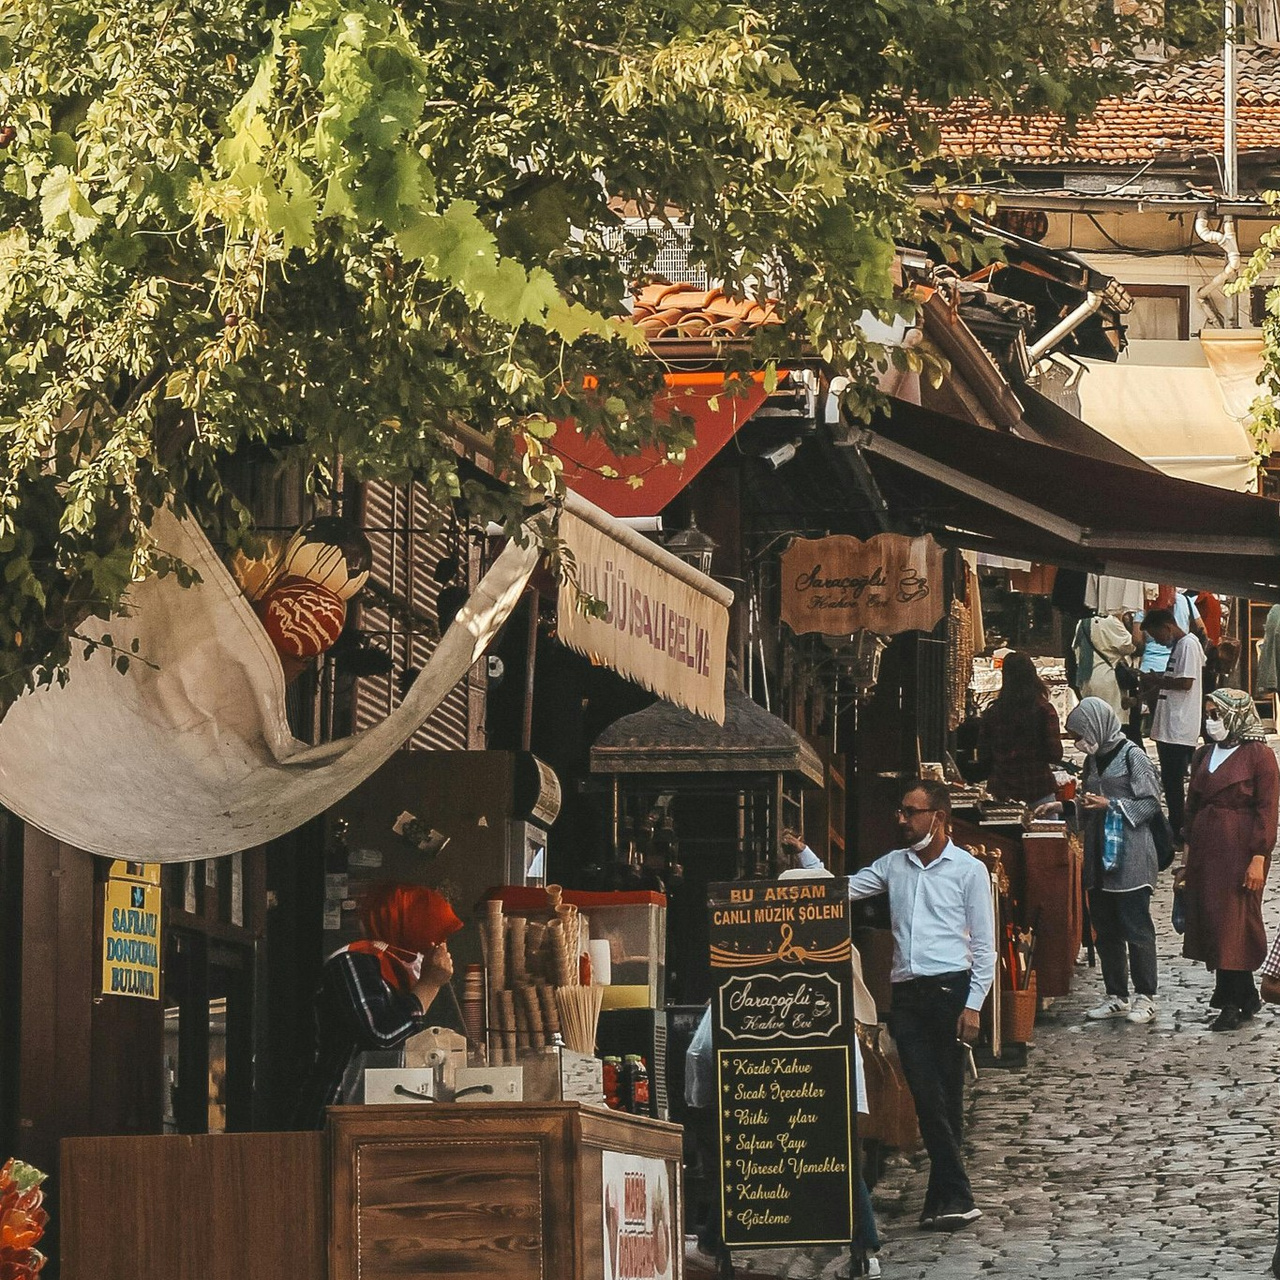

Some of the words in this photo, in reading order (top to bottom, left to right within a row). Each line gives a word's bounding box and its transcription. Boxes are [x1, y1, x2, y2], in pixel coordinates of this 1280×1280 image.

[730, 889, 754, 903] BU
[764, 885, 826, 903] AKŞAM
[713, 910, 751, 926] CANLI
[754, 904, 795, 923] MÜZİK
[798, 901, 844, 925] ŞÖLENİ
[730, 981, 813, 1019] Saraçoğlu
[740, 1015, 786, 1031] Kahve
[792, 1013, 814, 1029] Evi
[733, 1058, 772, 1075] Közde
[771, 1058, 813, 1074] Kahve
[734, 1083, 766, 1100] Sıcak
[734, 1109, 770, 1126] Bitki
[736, 1133, 775, 1155] Safran
[777, 1132, 807, 1154] Çayı
[736, 1158, 785, 1180] Yöresel
[787, 1157, 847, 1179] Yemekler
[736, 1183, 790, 1200] Kahvaltı
[737, 1209, 791, 1230] Gözleme
